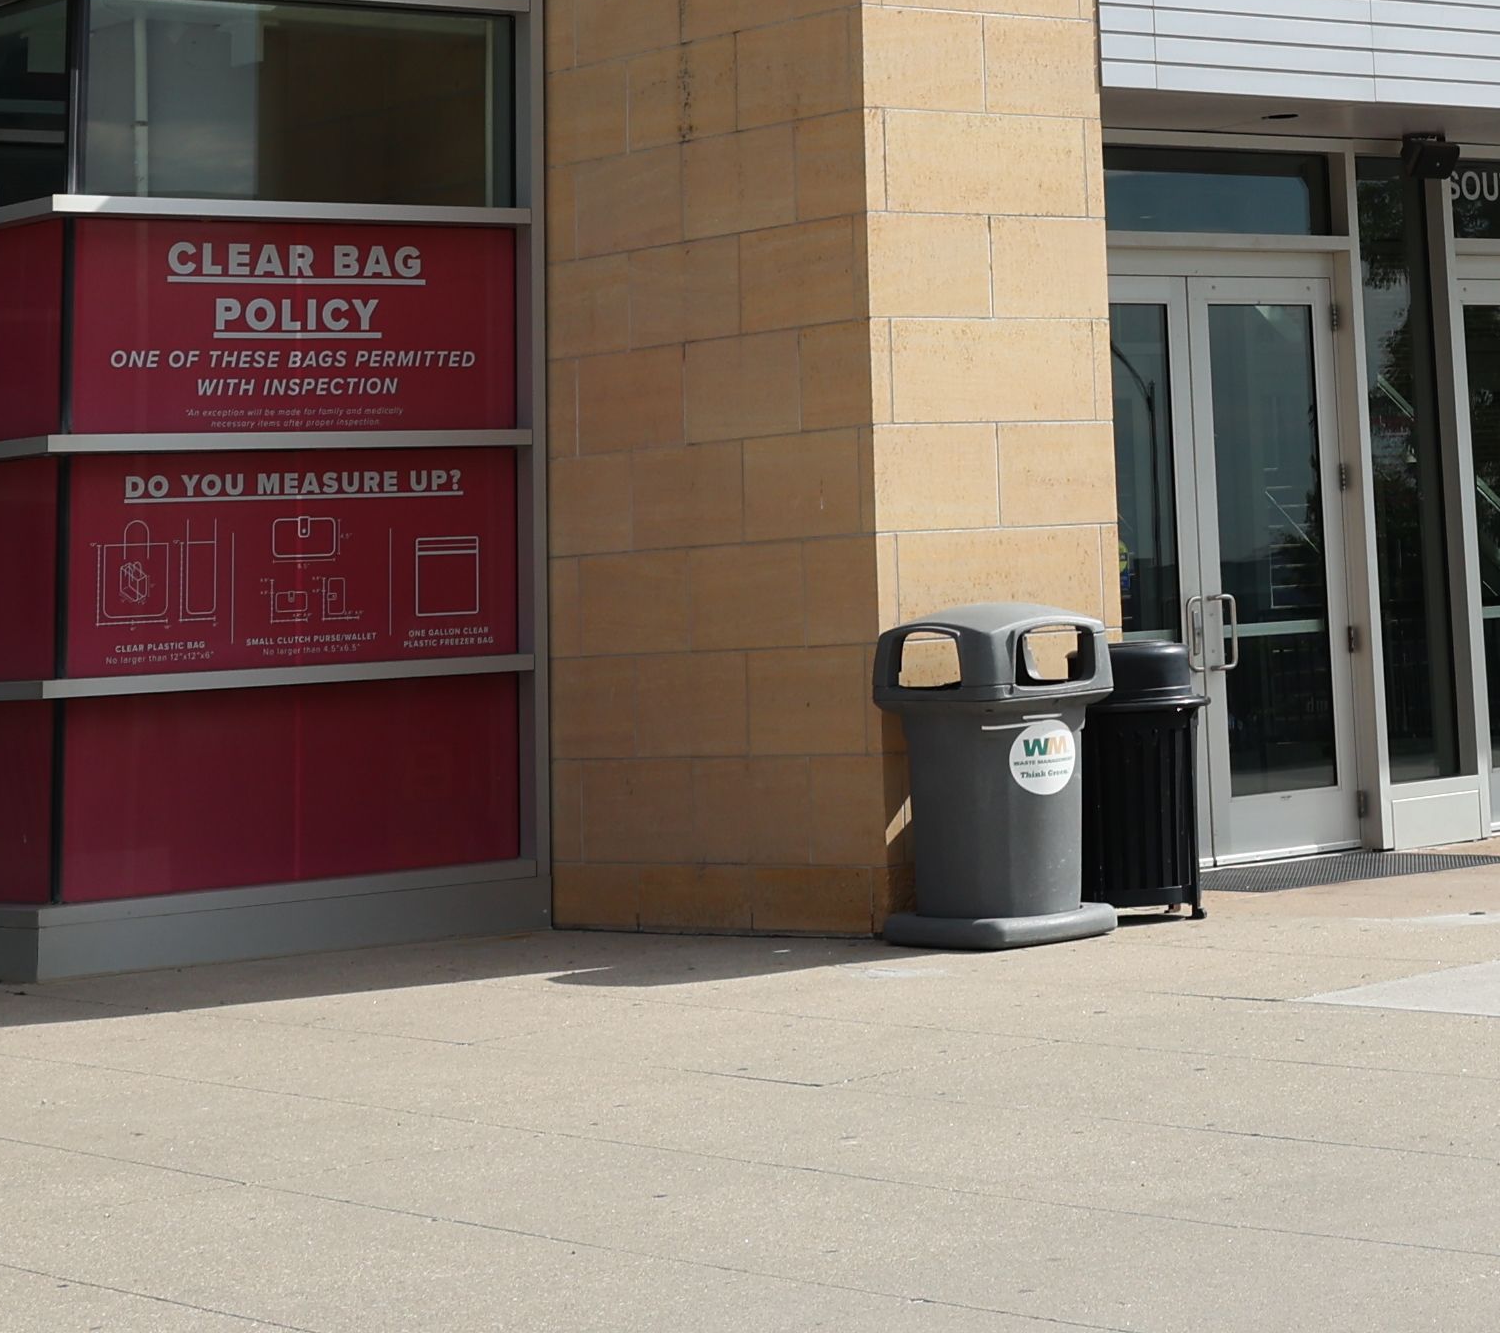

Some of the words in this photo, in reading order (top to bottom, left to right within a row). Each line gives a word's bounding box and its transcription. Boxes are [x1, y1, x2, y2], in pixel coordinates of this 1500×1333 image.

[167, 241, 314, 277] CLEAR
[334, 244, 422, 278] BAG
[215, 298, 380, 331] POLICY
[110, 350, 160, 369] ONE
[168, 350, 200, 368] OF
[209, 350, 280, 368] THESE
[287, 350, 347, 368] BAGS
[355, 351, 476, 368] PERMITTED
[197, 378, 256, 396] WITH
[263, 377, 399, 396] INSPECTION
[125, 475, 170, 498] DO
[181, 473, 245, 497] YOU
[258, 470, 399, 495] MEASURE
[410, 469, 462, 492] UP?
[246, 637, 276, 647] SMALL
[277, 635, 311, 645] CLUTCH
[314, 632, 377, 644] PURSE/WALLET
[408, 629, 426, 637] ONE
[428, 627, 461, 637] GALLON
[463, 625, 489, 635] CLEAR
[115, 643, 144, 653] CLEAR
[147, 641, 184, 652] PLASTIC
[187, 641, 206, 650] BAG
[403, 638, 437, 648] PLASTIC
[439, 637, 476, 647] FREEZER
[477, 635, 494, 645] BAG
[1023, 735, 1067, 757] WM
[1020, 770, 1047, 779] Think
